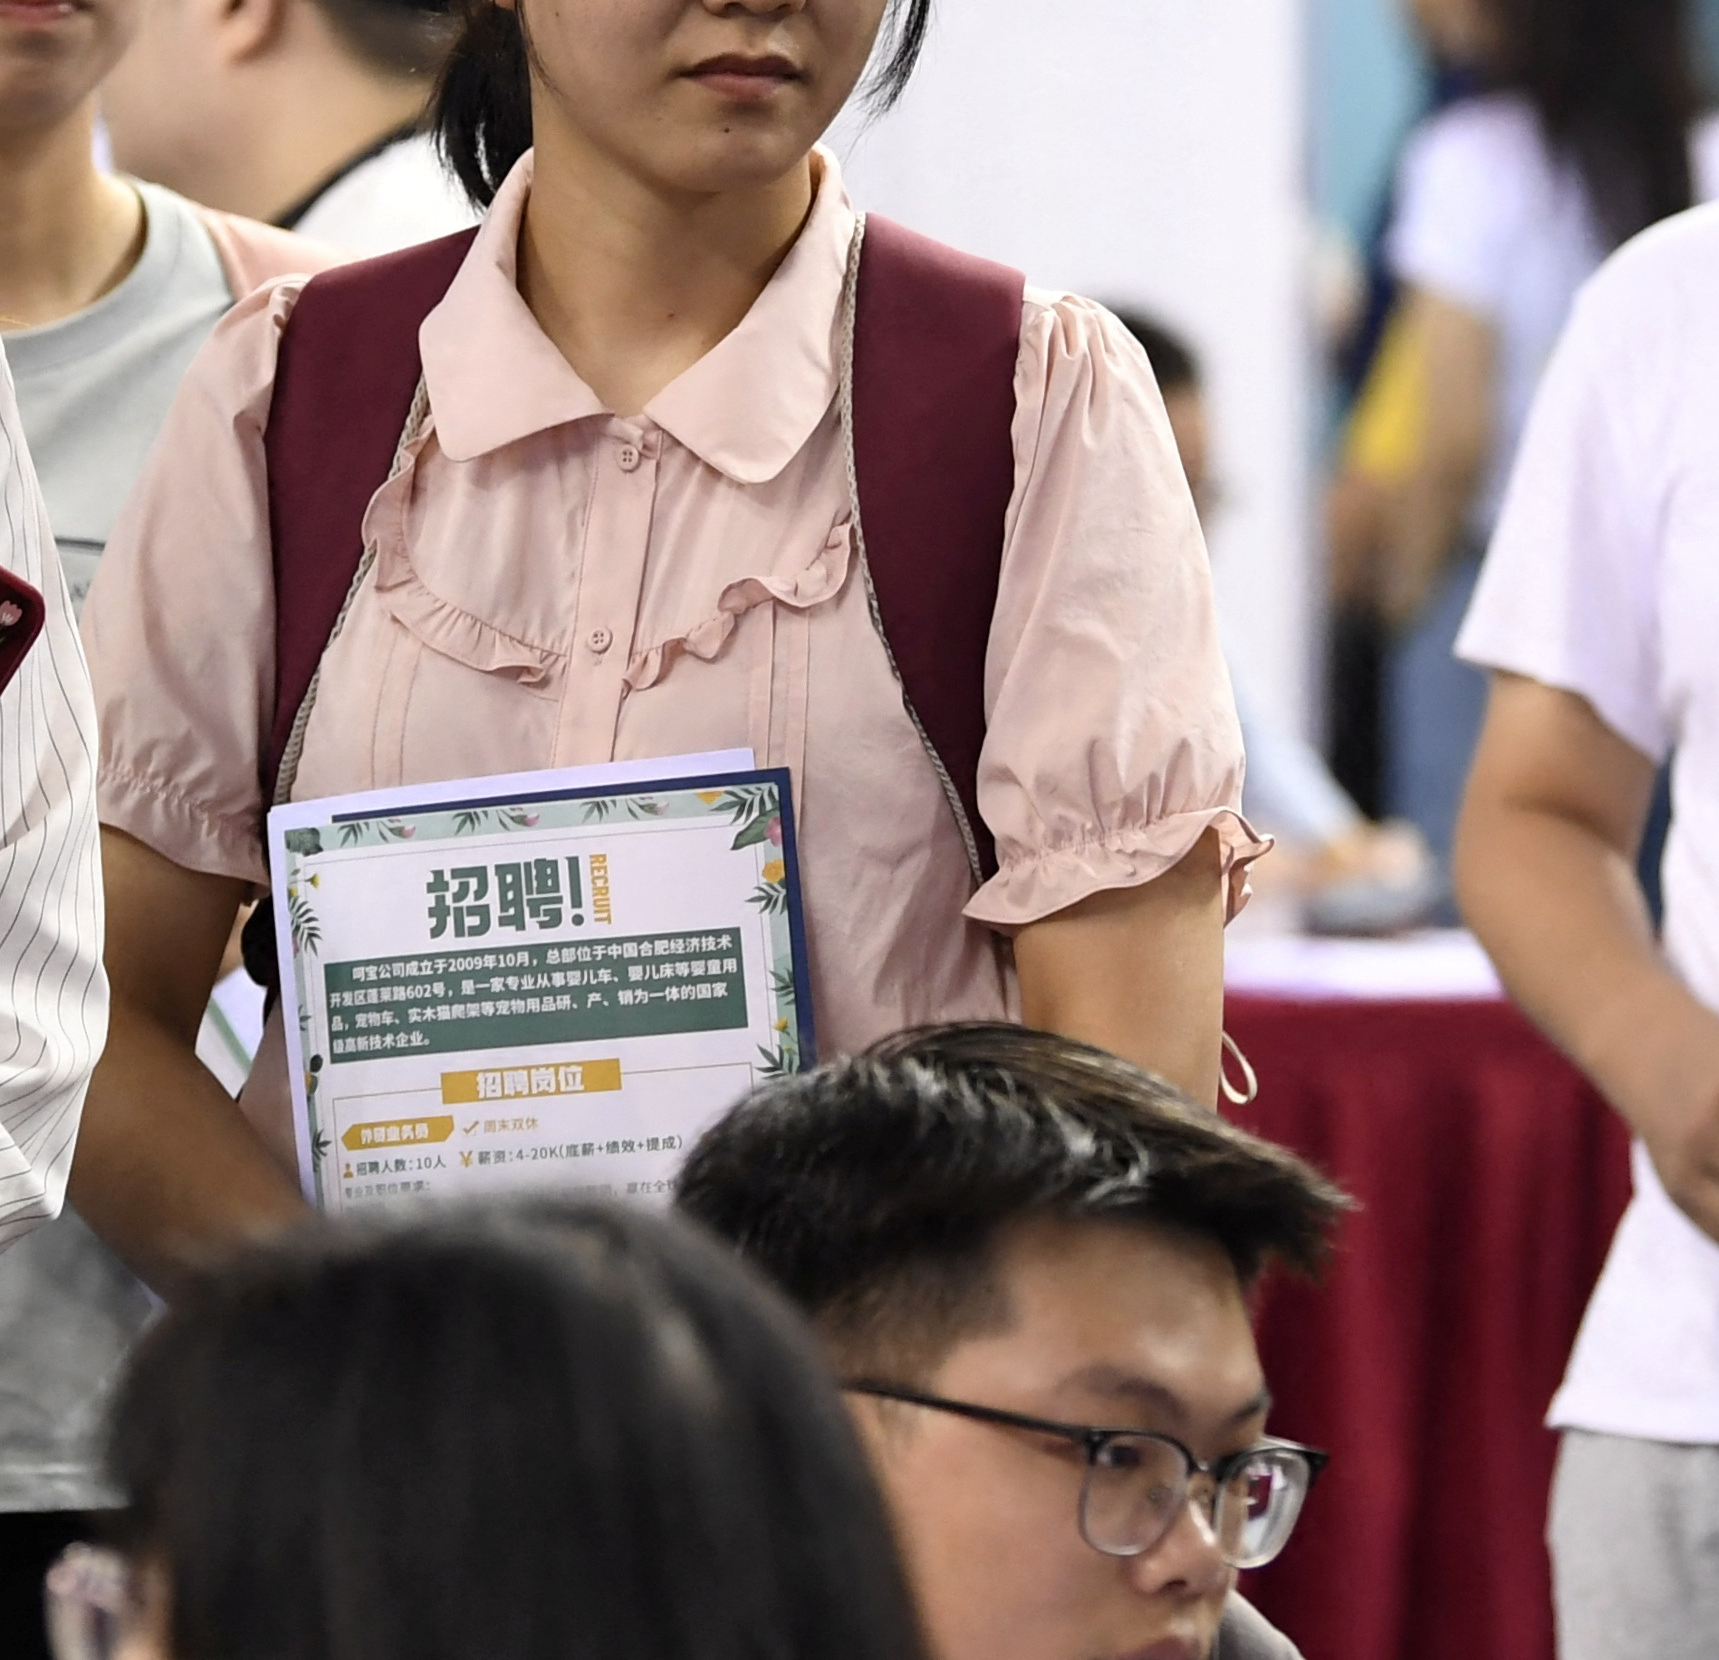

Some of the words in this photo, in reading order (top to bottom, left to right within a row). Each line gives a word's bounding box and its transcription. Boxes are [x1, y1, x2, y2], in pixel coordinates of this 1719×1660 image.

[589, 853, 612, 924] RECRUIT
[477, 1065, 584, 1099] 招聘岗位
[483, 1117, 538, 1134] 周末双休
